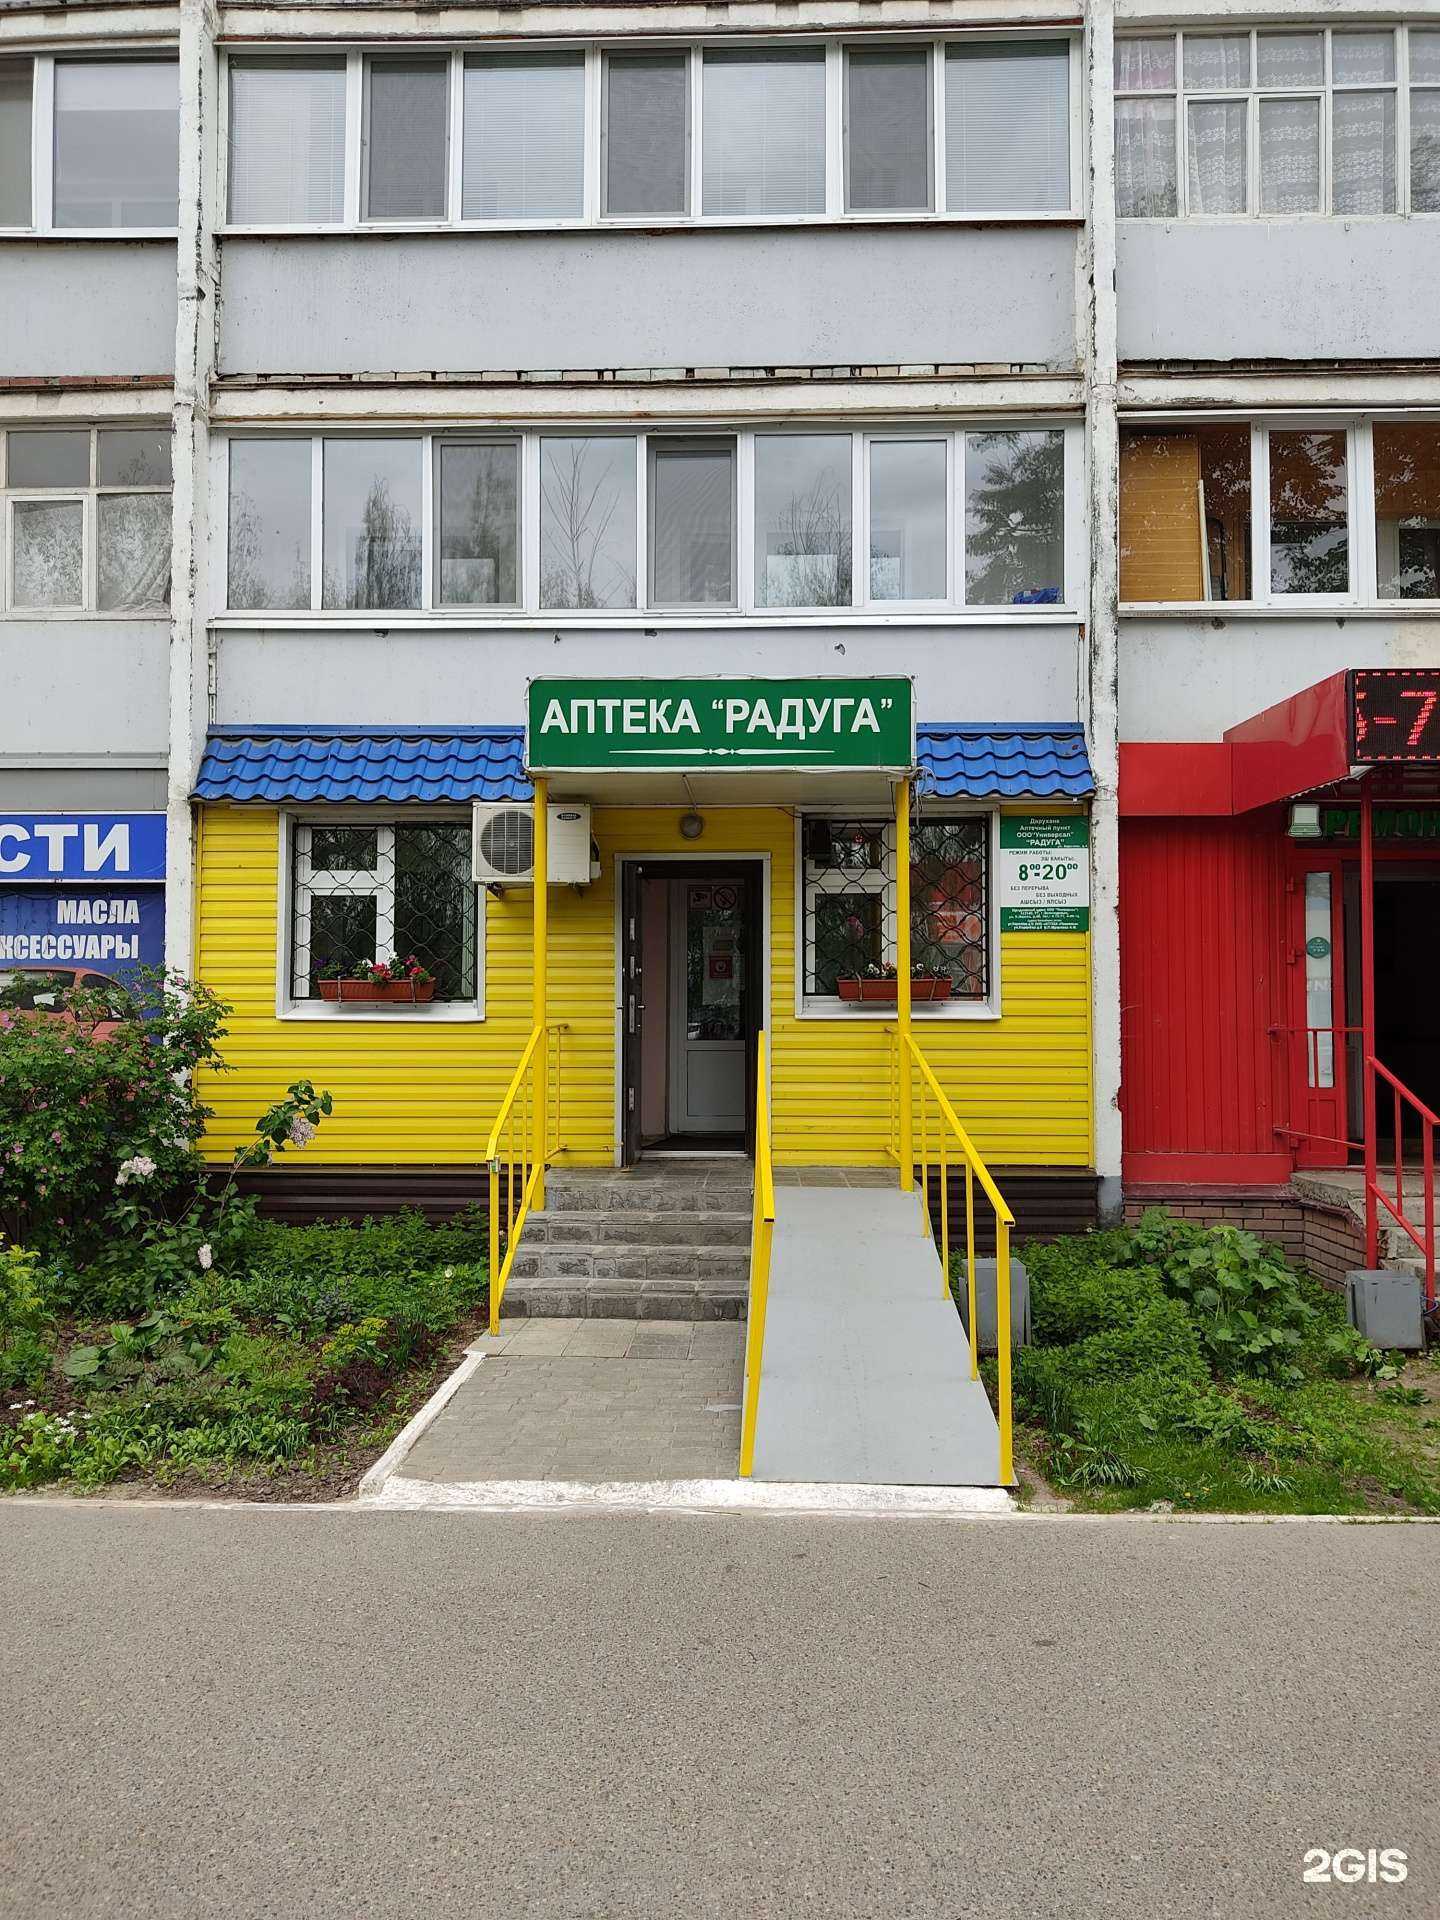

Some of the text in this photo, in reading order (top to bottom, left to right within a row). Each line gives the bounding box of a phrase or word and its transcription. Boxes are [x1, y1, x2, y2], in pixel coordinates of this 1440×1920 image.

[539, 698, 701, 734] АПТЕКА
[0, 824, 130, 873] СТИ
[57, 899, 140, 924] МАСЛА
